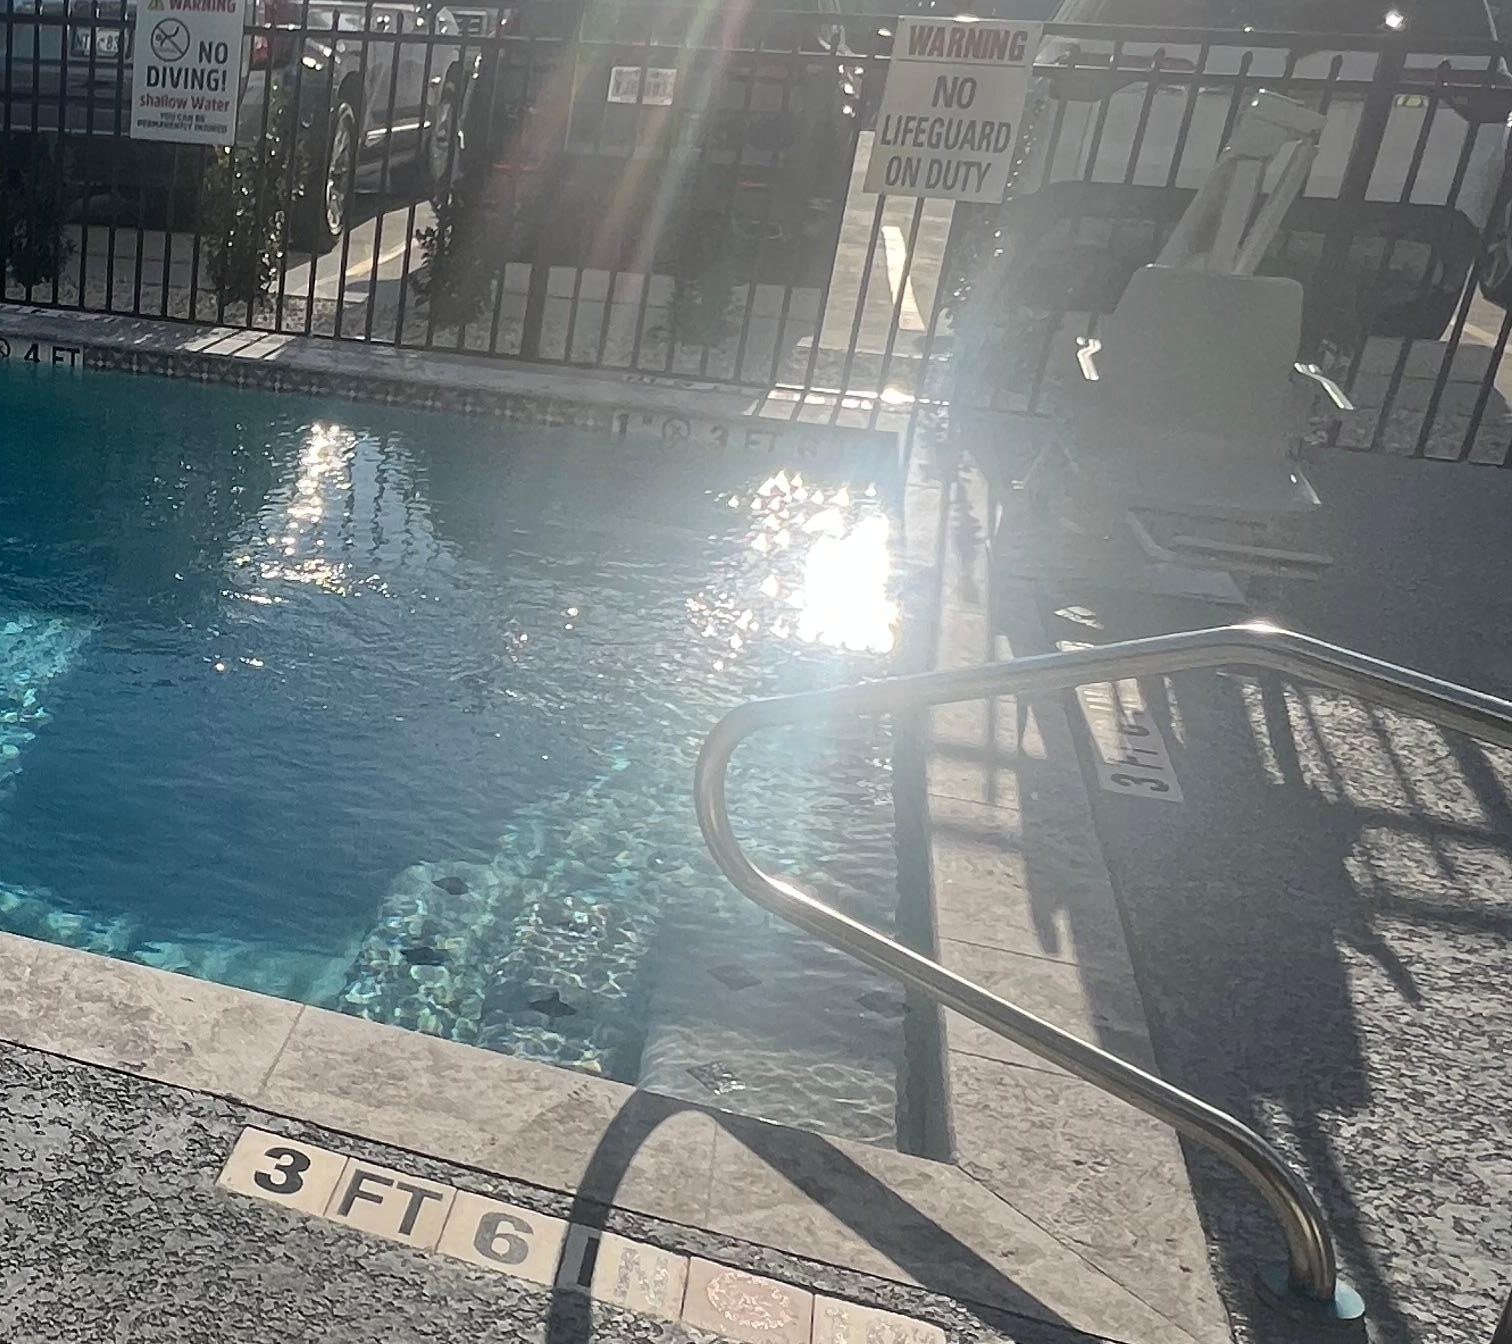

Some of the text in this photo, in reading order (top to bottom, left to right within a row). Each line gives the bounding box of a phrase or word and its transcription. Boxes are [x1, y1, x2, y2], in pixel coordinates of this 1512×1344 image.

[198, 40, 228, 65] NO
[908, 24, 1029, 61] WARNING
[146, 65, 227, 92] DIVING!
[932, 75, 977, 109] NO
[190, 95, 230, 112] Water
[880, 114, 1011, 153] LIFEGUARD
[885, 156, 991, 193] ON DUTY
[24, 343, 40, 363] 4
[52, 346, 80, 367] FT
[1110, 773, 1170, 792] 3
[253, 1146, 312, 1196] 3
[336, 1168, 445, 1237] FT
[472, 1212, 535, 1266] 6
